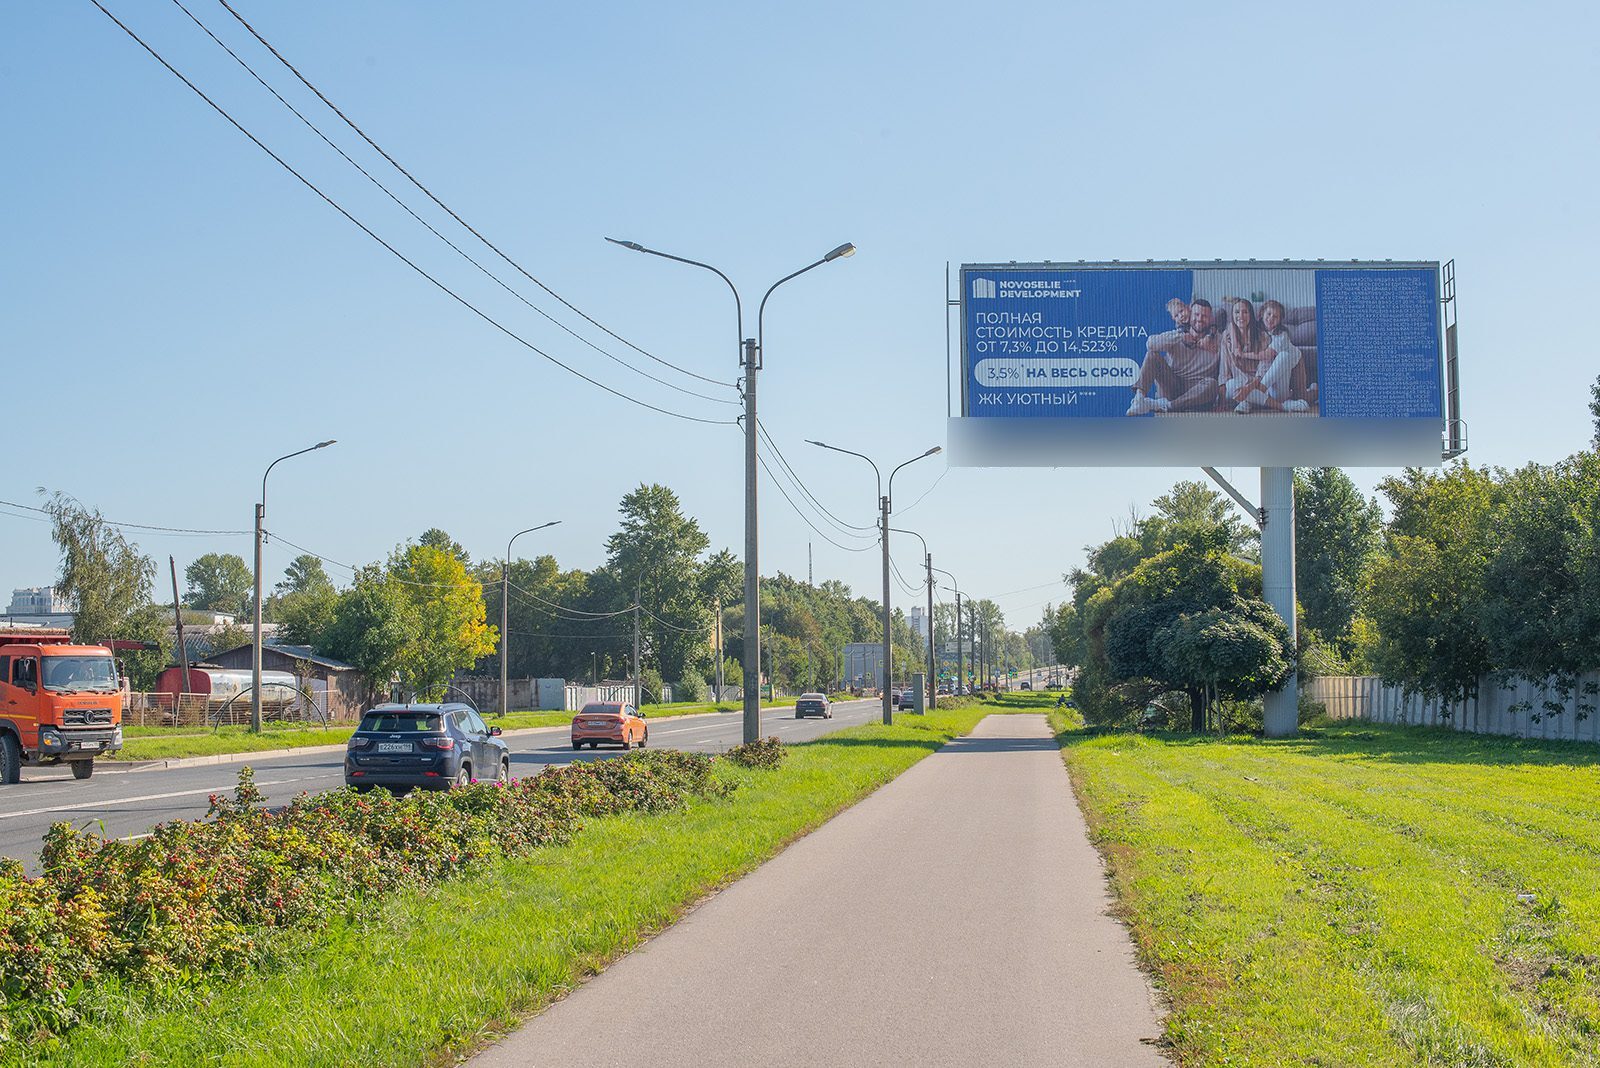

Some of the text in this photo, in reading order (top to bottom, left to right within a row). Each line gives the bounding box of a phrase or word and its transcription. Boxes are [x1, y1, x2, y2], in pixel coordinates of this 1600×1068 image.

[1000, 281, 1061, 289] NOVOSELIE
[1000, 290, 1082, 298] DEVELOPMENT
[976, 312, 1042, 324] ПОЛНАЯ
[976, 326, 1148, 339] СТОИМОСТЬ КРЕДИТА
[976, 341, 1118, 354] ОТ 7,3% ДО 14,523%
[1026, 367, 1047, 378] НА
[1051, 367, 1087, 378] ВЕСЬ
[1090, 367, 1133, 378] СРОК!
[978, 393, 1003, 405] ЖК
